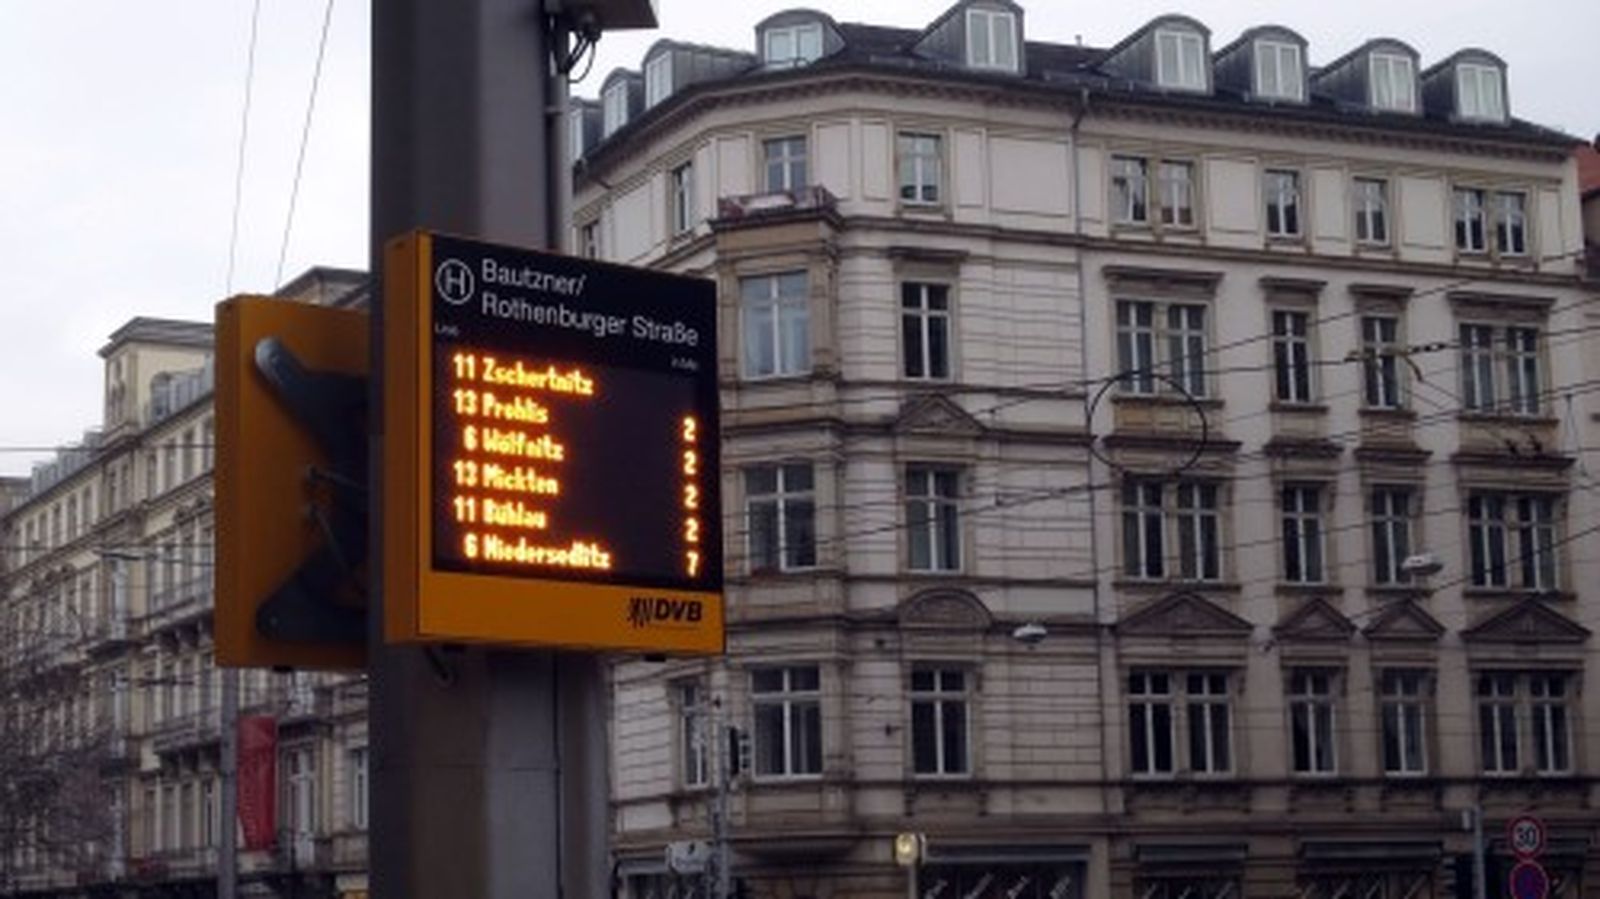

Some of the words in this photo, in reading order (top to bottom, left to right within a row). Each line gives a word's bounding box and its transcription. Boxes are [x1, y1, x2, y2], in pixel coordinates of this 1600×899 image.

[481, 258, 587, 296] Bautzner/
[481, 292, 626, 337] Rothenburger
[632, 316, 699, 346] Straße
[453, 354, 476, 380] 11
[482, 357, 594, 395] Zschertnitz
[453, 389, 478, 415] 13
[482, 392, 548, 424] Prohlis
[683, 417, 697, 442] 2
[463, 425, 478, 450] 6
[683, 451, 697, 476] 2
[453, 460, 478, 486] 13
[482, 463, 559, 494] Mickten
[684, 484, 698, 508] 2
[453, 495, 476, 522] 11
[685, 518, 699, 542] 2
[463, 533, 478, 558] 6
[483, 534, 611, 570] Niedersedlitz
[686, 551, 699, 577] 7
[655, 598, 703, 622] DVB
[1516, 826, 1536, 847] 30
